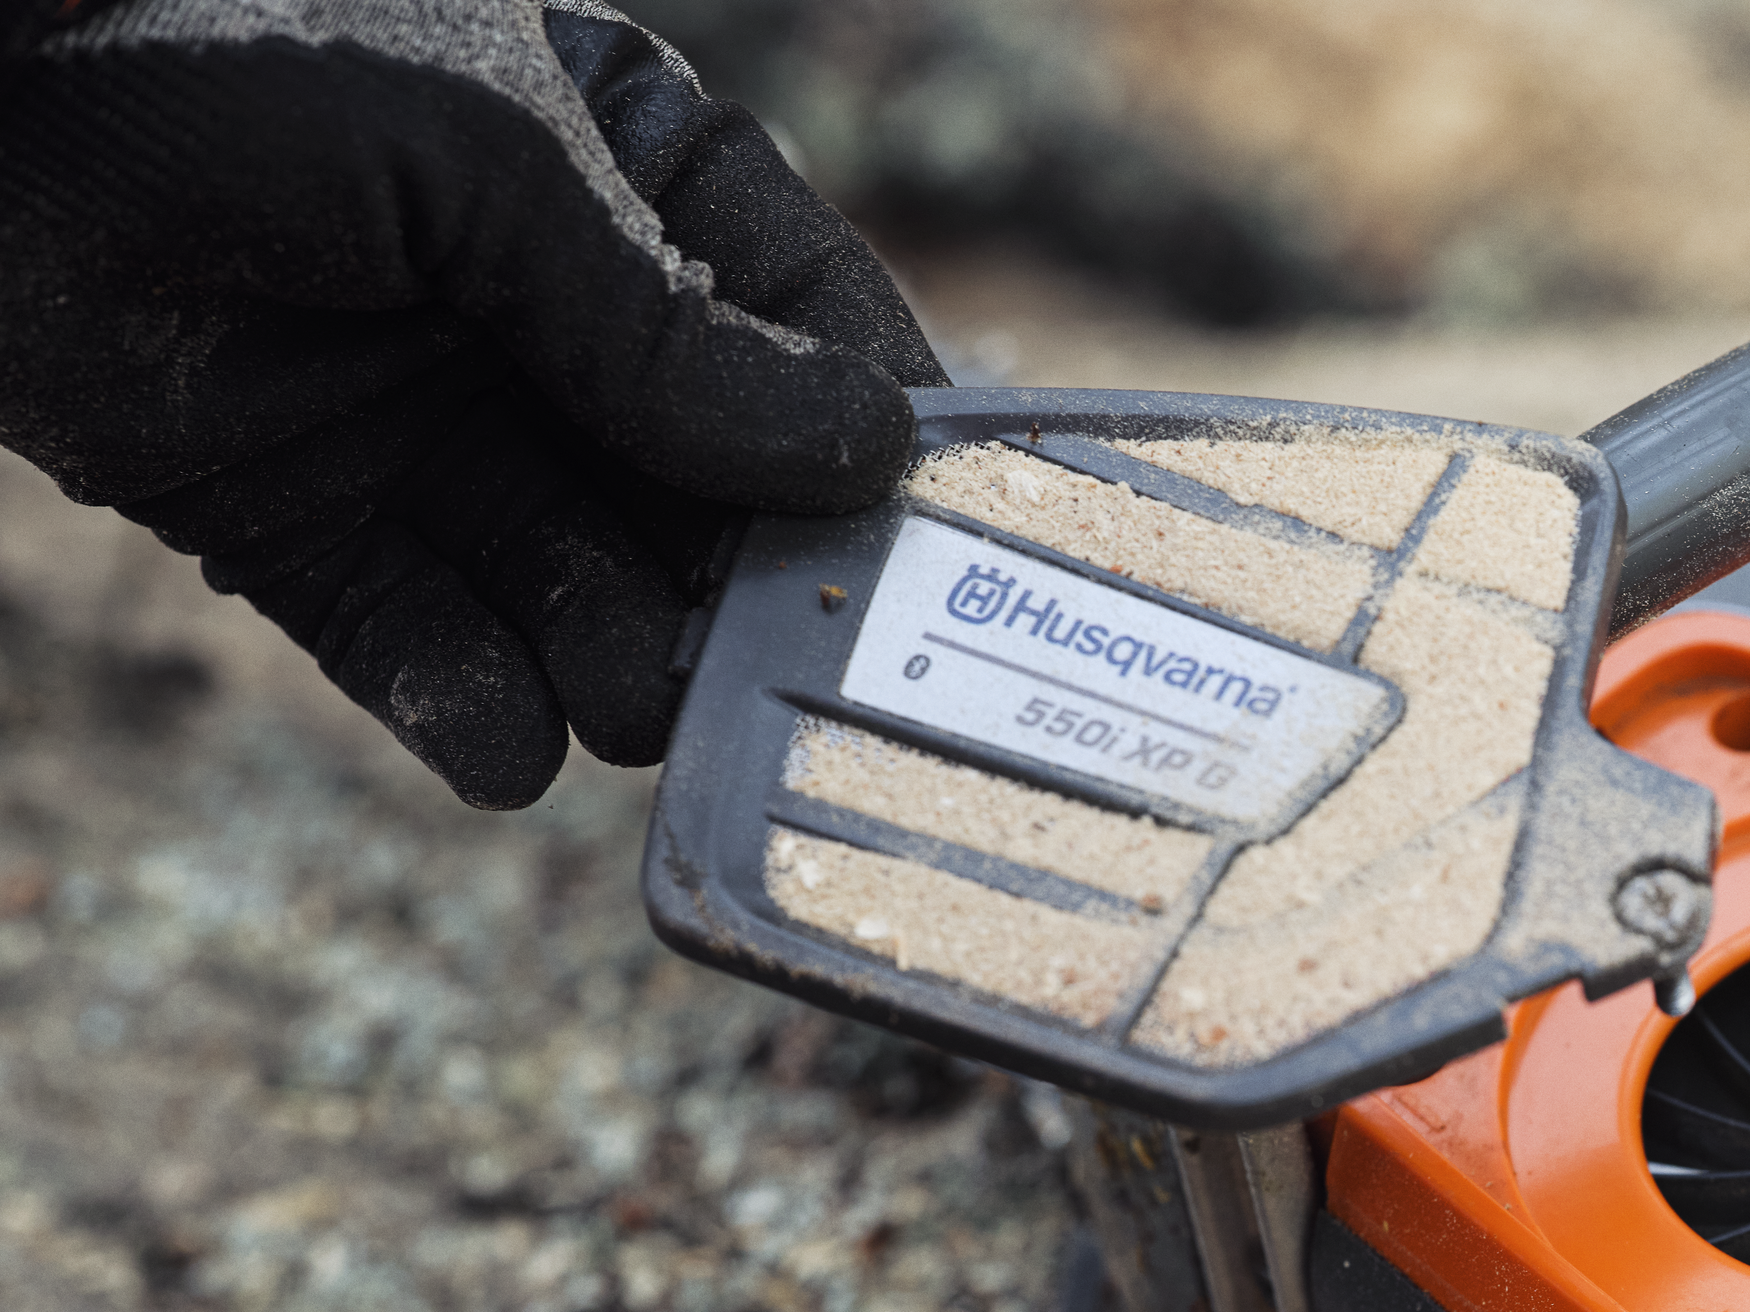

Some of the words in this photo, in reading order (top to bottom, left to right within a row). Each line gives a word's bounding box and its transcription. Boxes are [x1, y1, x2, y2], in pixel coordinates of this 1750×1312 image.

[1003, 587, 1283, 719] Husqvarna
[1014, 697, 1126, 755] 550i
[1120, 735, 1195, 773] XP
